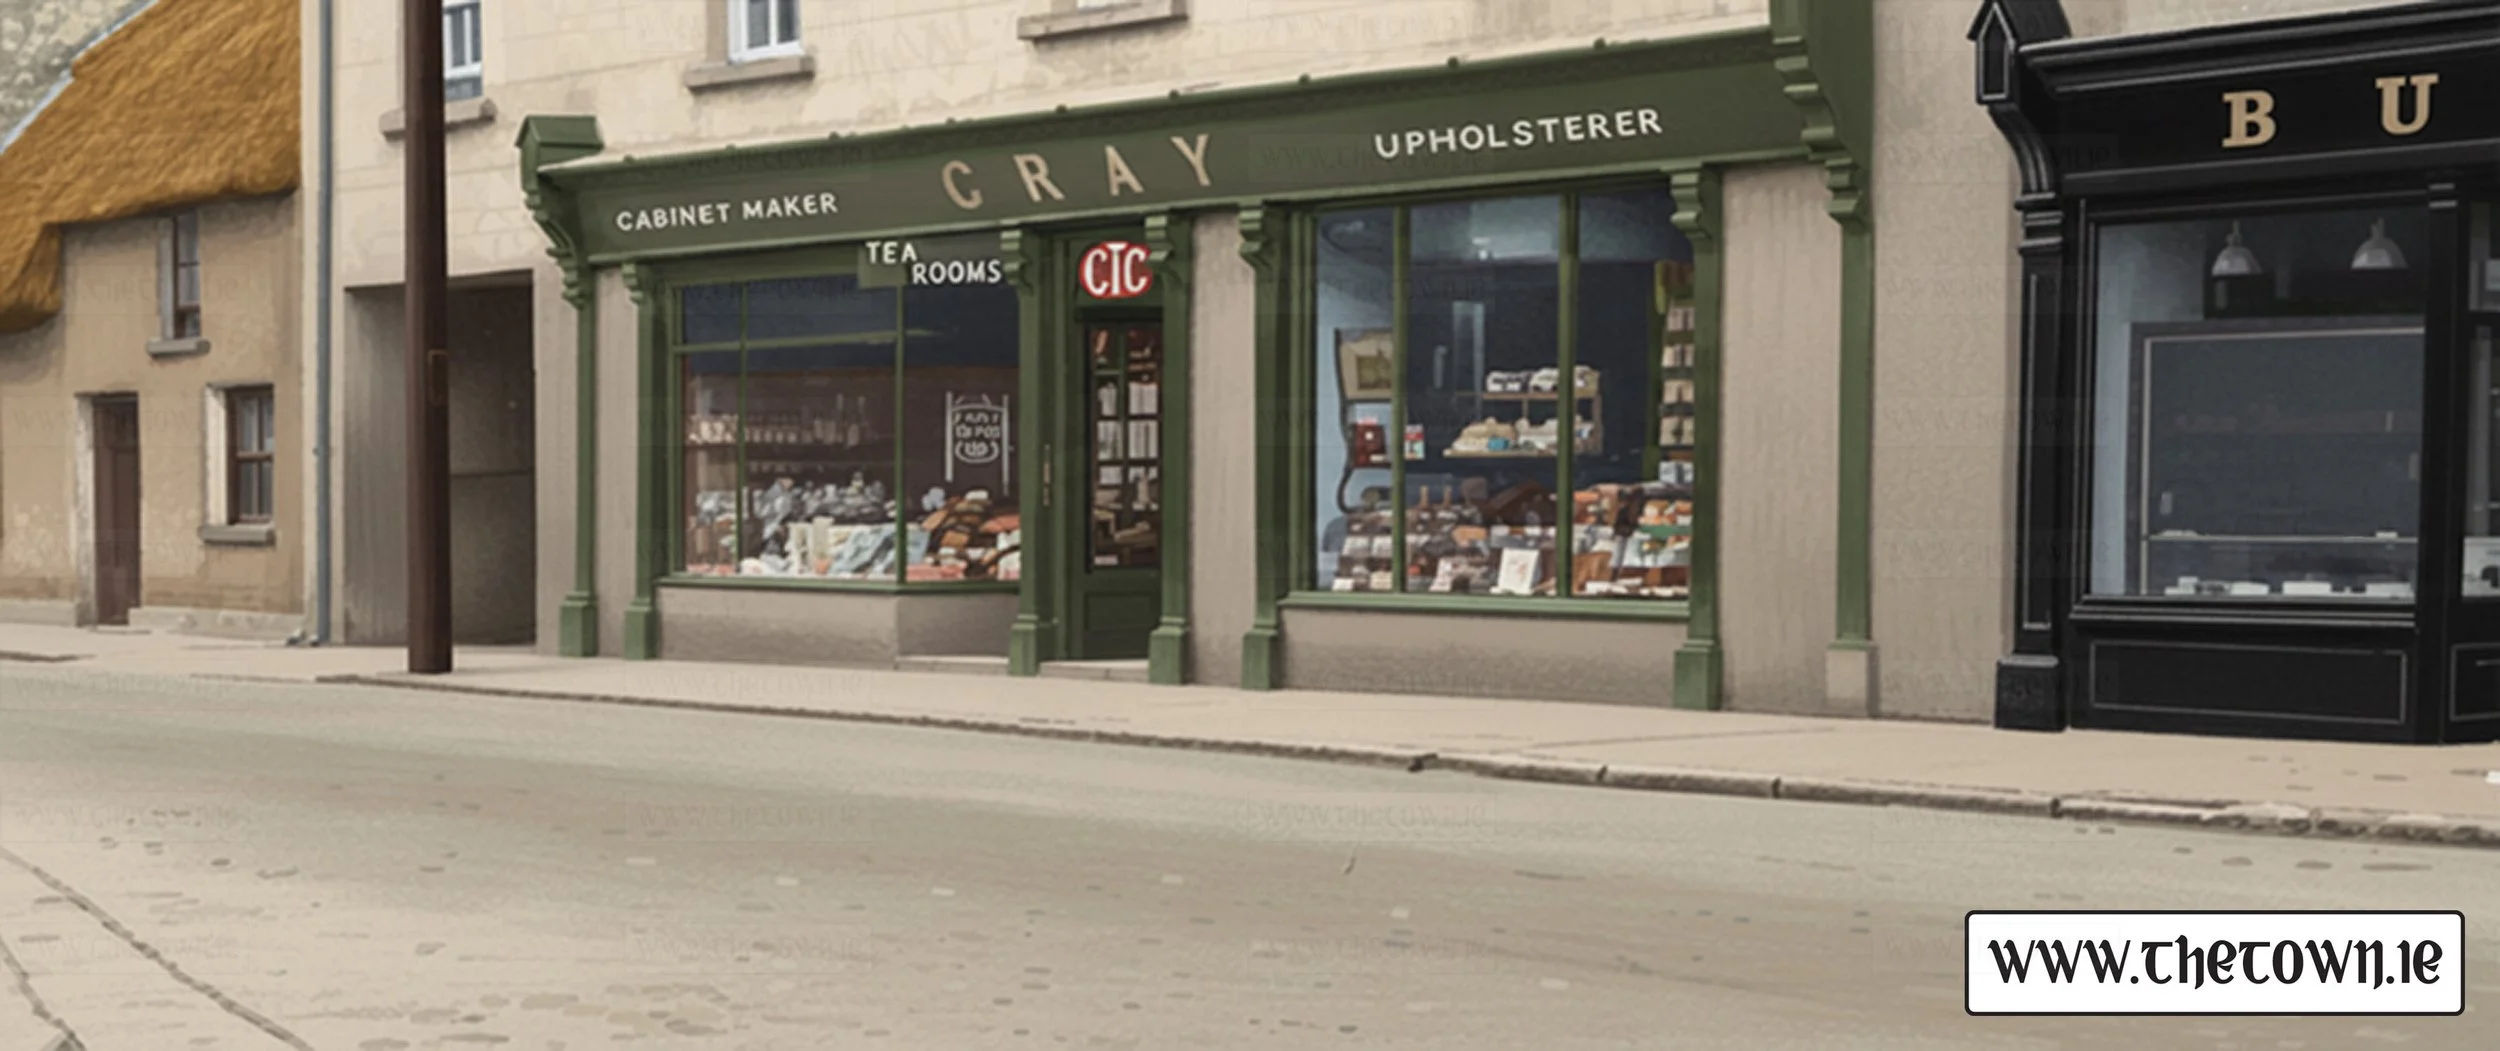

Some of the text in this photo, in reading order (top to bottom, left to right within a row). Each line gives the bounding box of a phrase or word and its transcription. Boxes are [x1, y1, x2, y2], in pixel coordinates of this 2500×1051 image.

[1374, 108, 1663, 158] UPHOLSTERER
[616, 192, 838, 231] CABINET MAKER
[866, 241, 917, 264] TEA
[1083, 242, 1148, 296] CTC
[912, 260, 1002, 285] ROOMS
